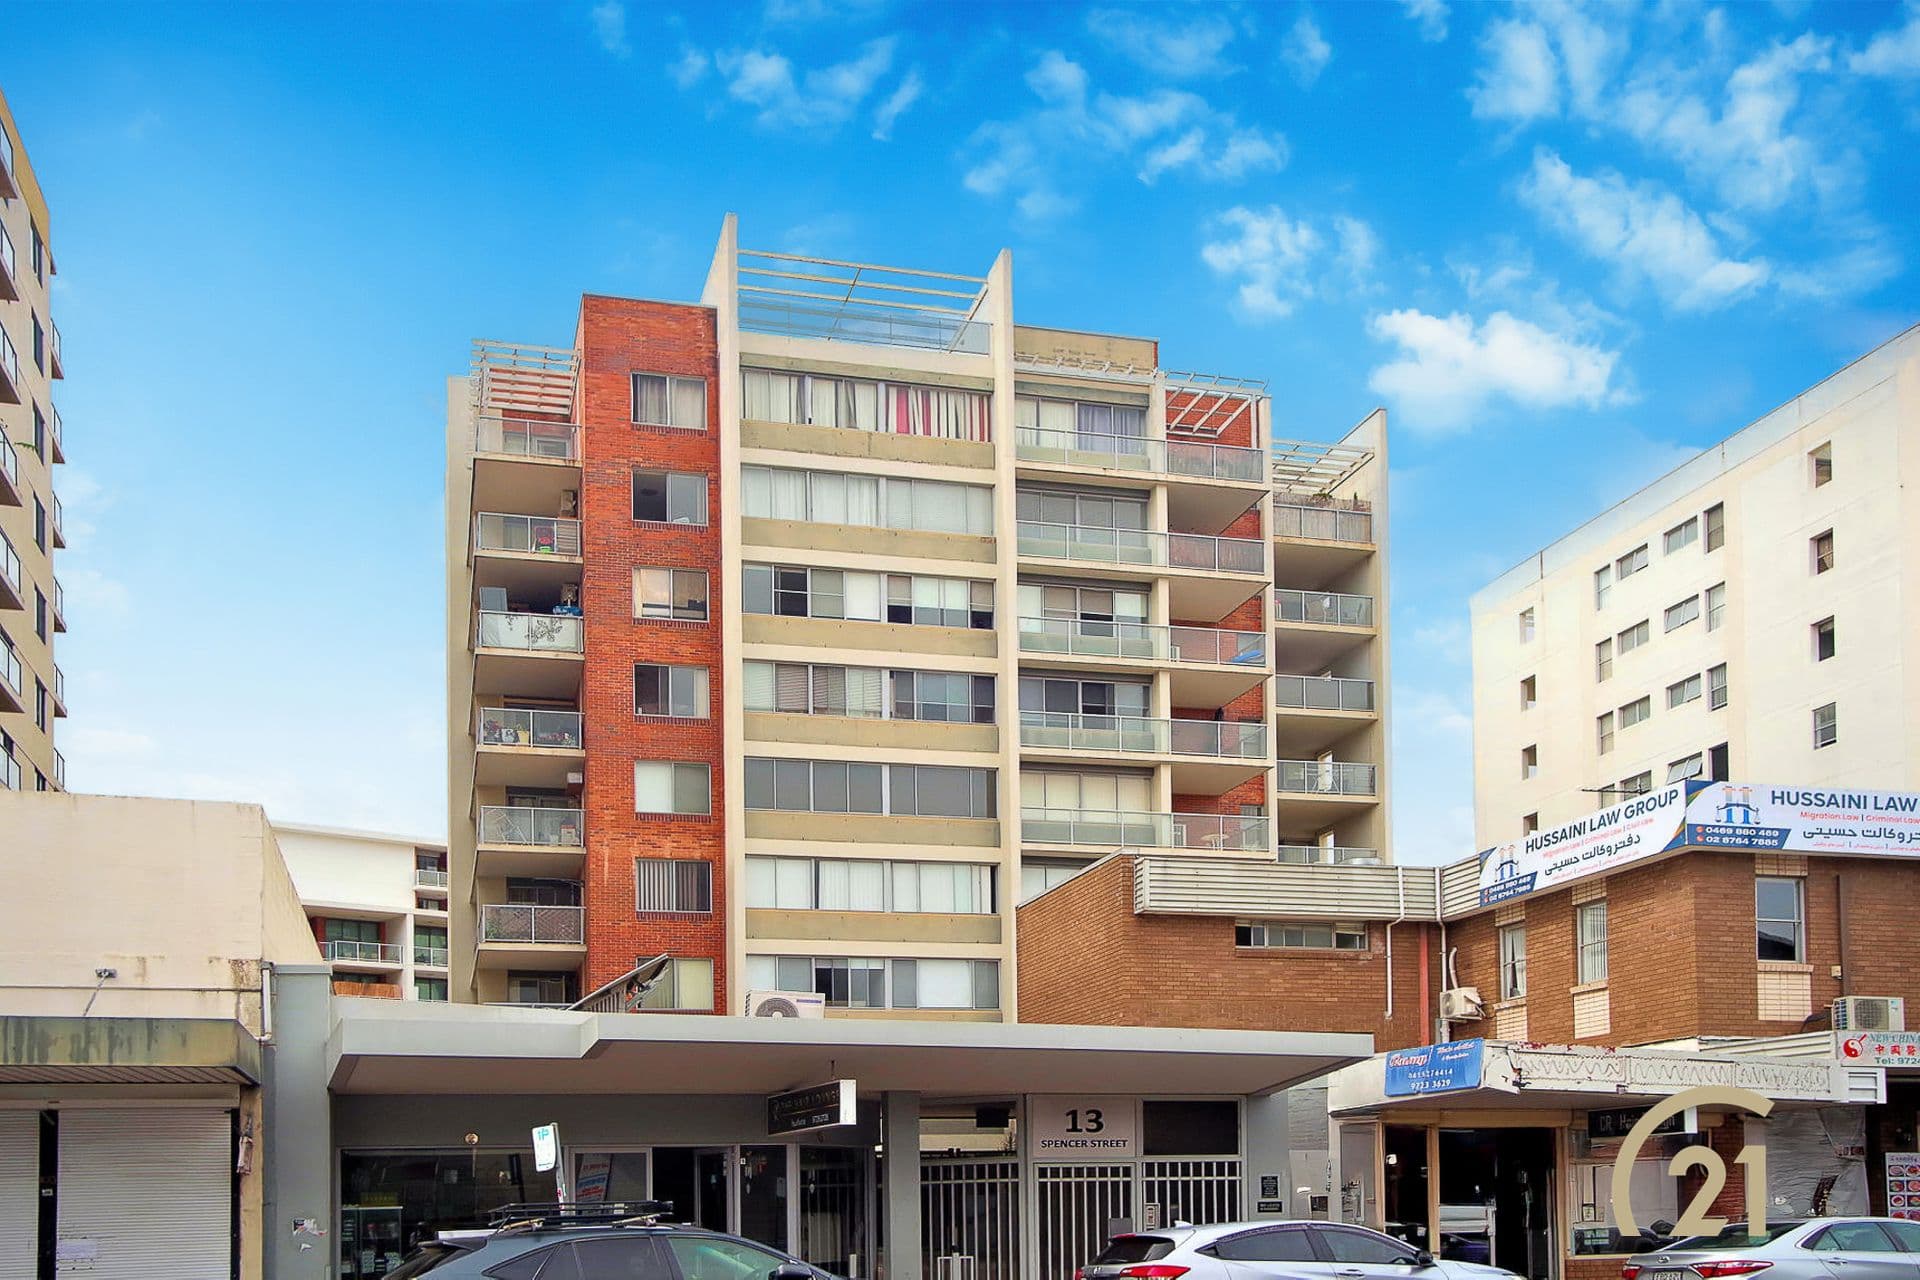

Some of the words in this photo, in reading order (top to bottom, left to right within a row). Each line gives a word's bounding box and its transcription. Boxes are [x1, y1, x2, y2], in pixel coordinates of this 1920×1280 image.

[1771, 790, 1867, 810] HUSSAINI
[1874, 796, 1918, 812] LAW
[1525, 821, 1586, 854] HUSSAINI
[1590, 809, 1621, 832] LAW
[1624, 789, 1679, 819] GROUP
[1800, 811, 1841, 822] Migration
[1843, 814, 1859, 822] Law
[1866, 815, 1902, 823] Criminal
[1706, 826, 1733, 834] 0469
[1758, 829, 1779, 837] 469
[1874, 1057, 1894, 1065] Tel:
[1065, 1109, 1104, 1133] 13
[1041, 1139, 1088, 1149] SPENCER
[1090, 1139, 1128, 1149] STREET
